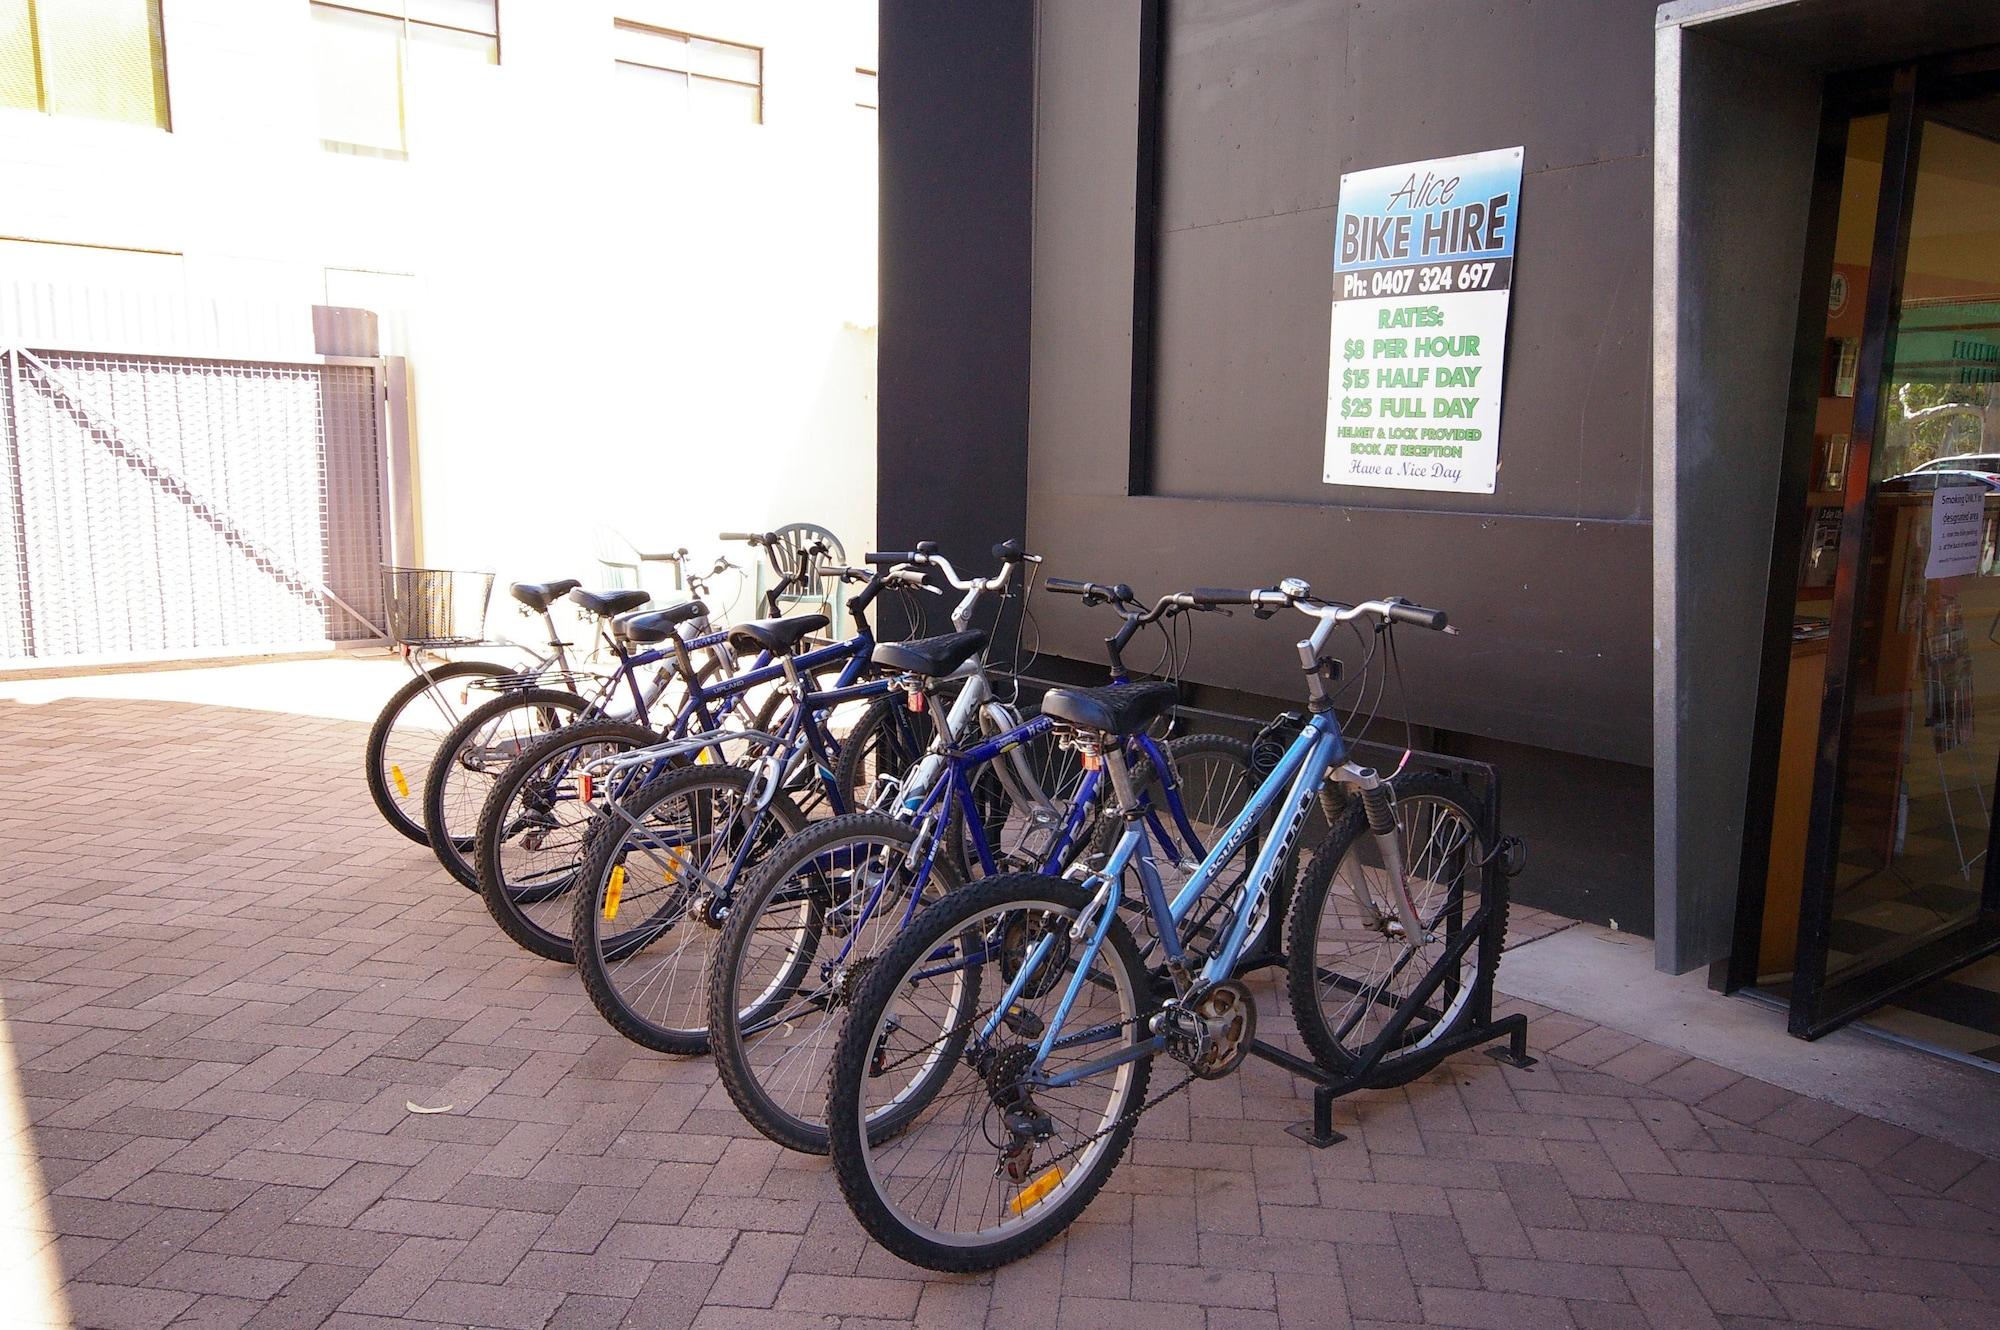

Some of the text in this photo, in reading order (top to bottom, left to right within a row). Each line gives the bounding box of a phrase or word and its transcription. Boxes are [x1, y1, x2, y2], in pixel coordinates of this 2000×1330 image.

[1387, 171, 1460, 211] Alice
[1341, 192, 1510, 265] BIKE HIRE
[1343, 262, 1496, 298] Ph: 0407 324 697
[1378, 306, 1444, 329] RATES:
[1343, 335, 1481, 362] $8 PER HOUR
[1342, 366, 1482, 391] $15 HALF DAY
[1340, 397, 1480, 420] $25 FULL DAY
[1338, 426, 1482, 441] HELMET & LOCK PROVIDED
[1350, 442, 1462, 458] BOOK AT RECEPTION
[1349, 459, 1462, 483] Have a Nice Day
[713, 680, 745, 694] UPLAND
[1206, 814, 1256, 878] Boulder
